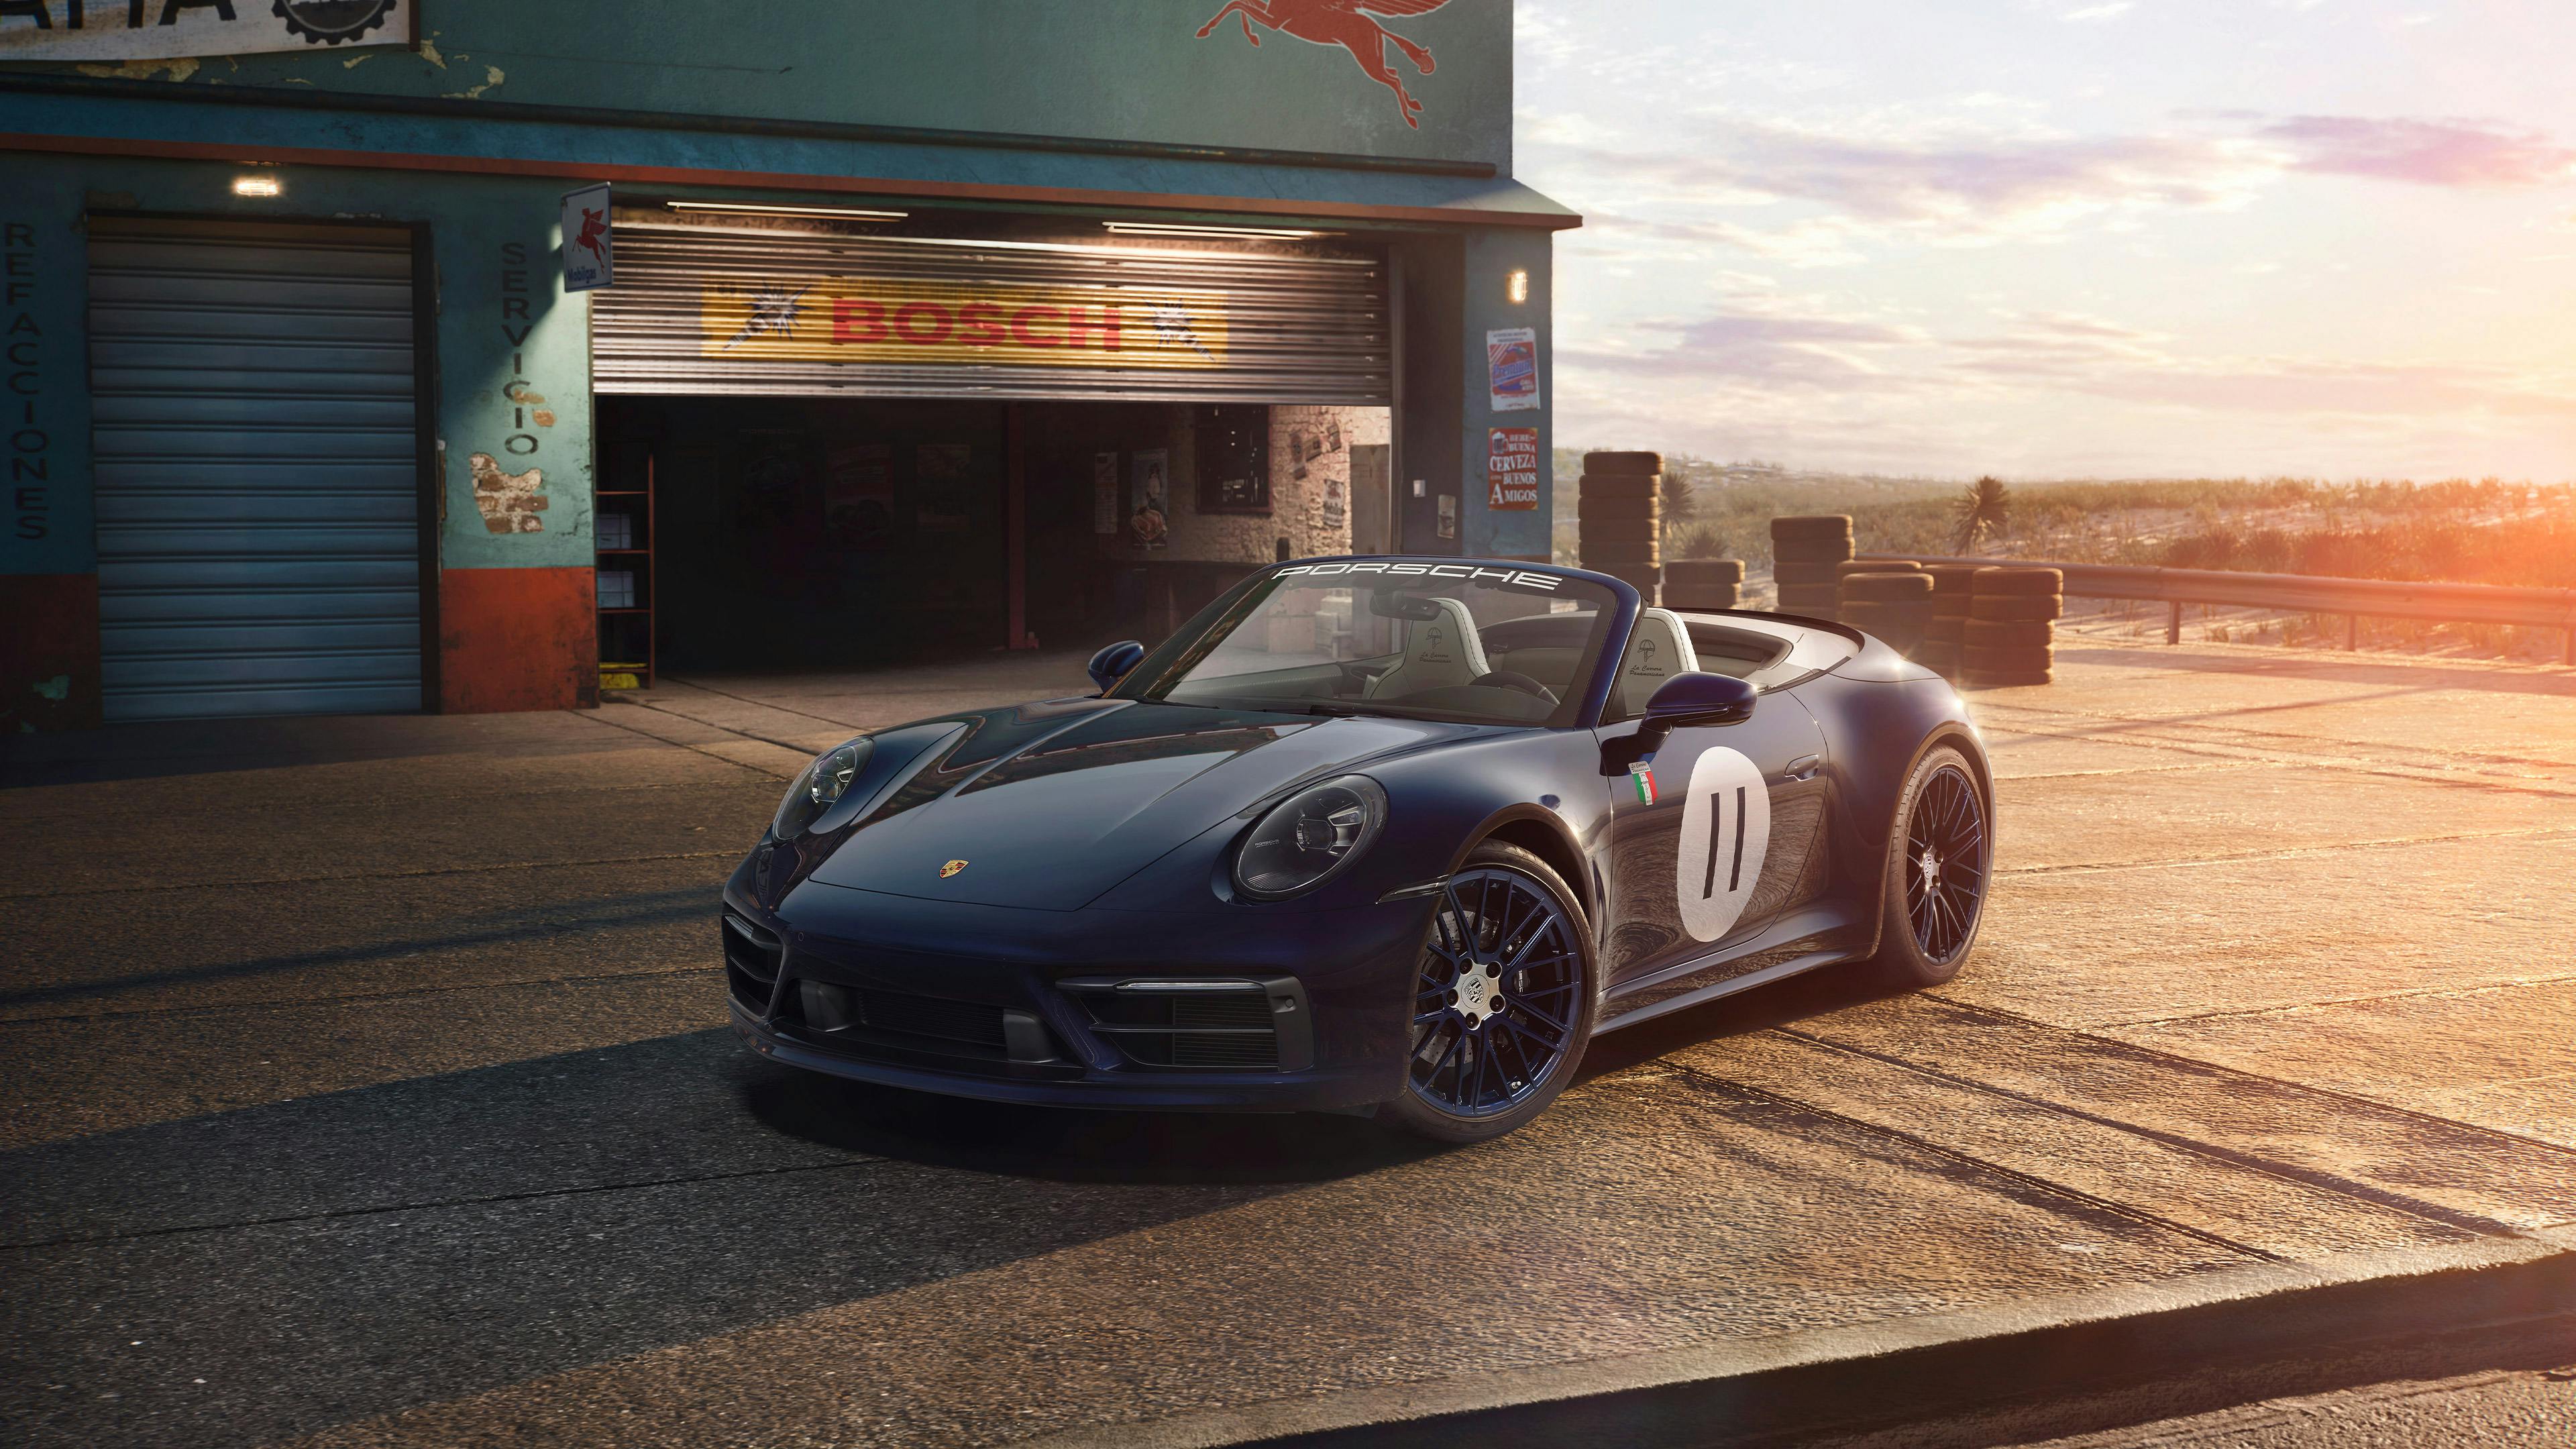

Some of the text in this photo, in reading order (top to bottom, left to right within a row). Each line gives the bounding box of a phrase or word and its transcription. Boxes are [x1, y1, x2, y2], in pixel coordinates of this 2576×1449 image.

[832, 298, 1121, 350] BOSCH
[500, 242, 539, 456] SERVICIO
[4, 222, 50, 540] REFACCIONES
[1509, 443, 1536, 453] BUENA
[1490, 454, 1536, 472] CERVEZA
[1503, 472, 1536, 484] BUENOS
[1490, 483, 1538, 504] AMIGOS
[1271, 563, 1563, 590] PORSCHE
[1702, 786, 1746, 900] 11
